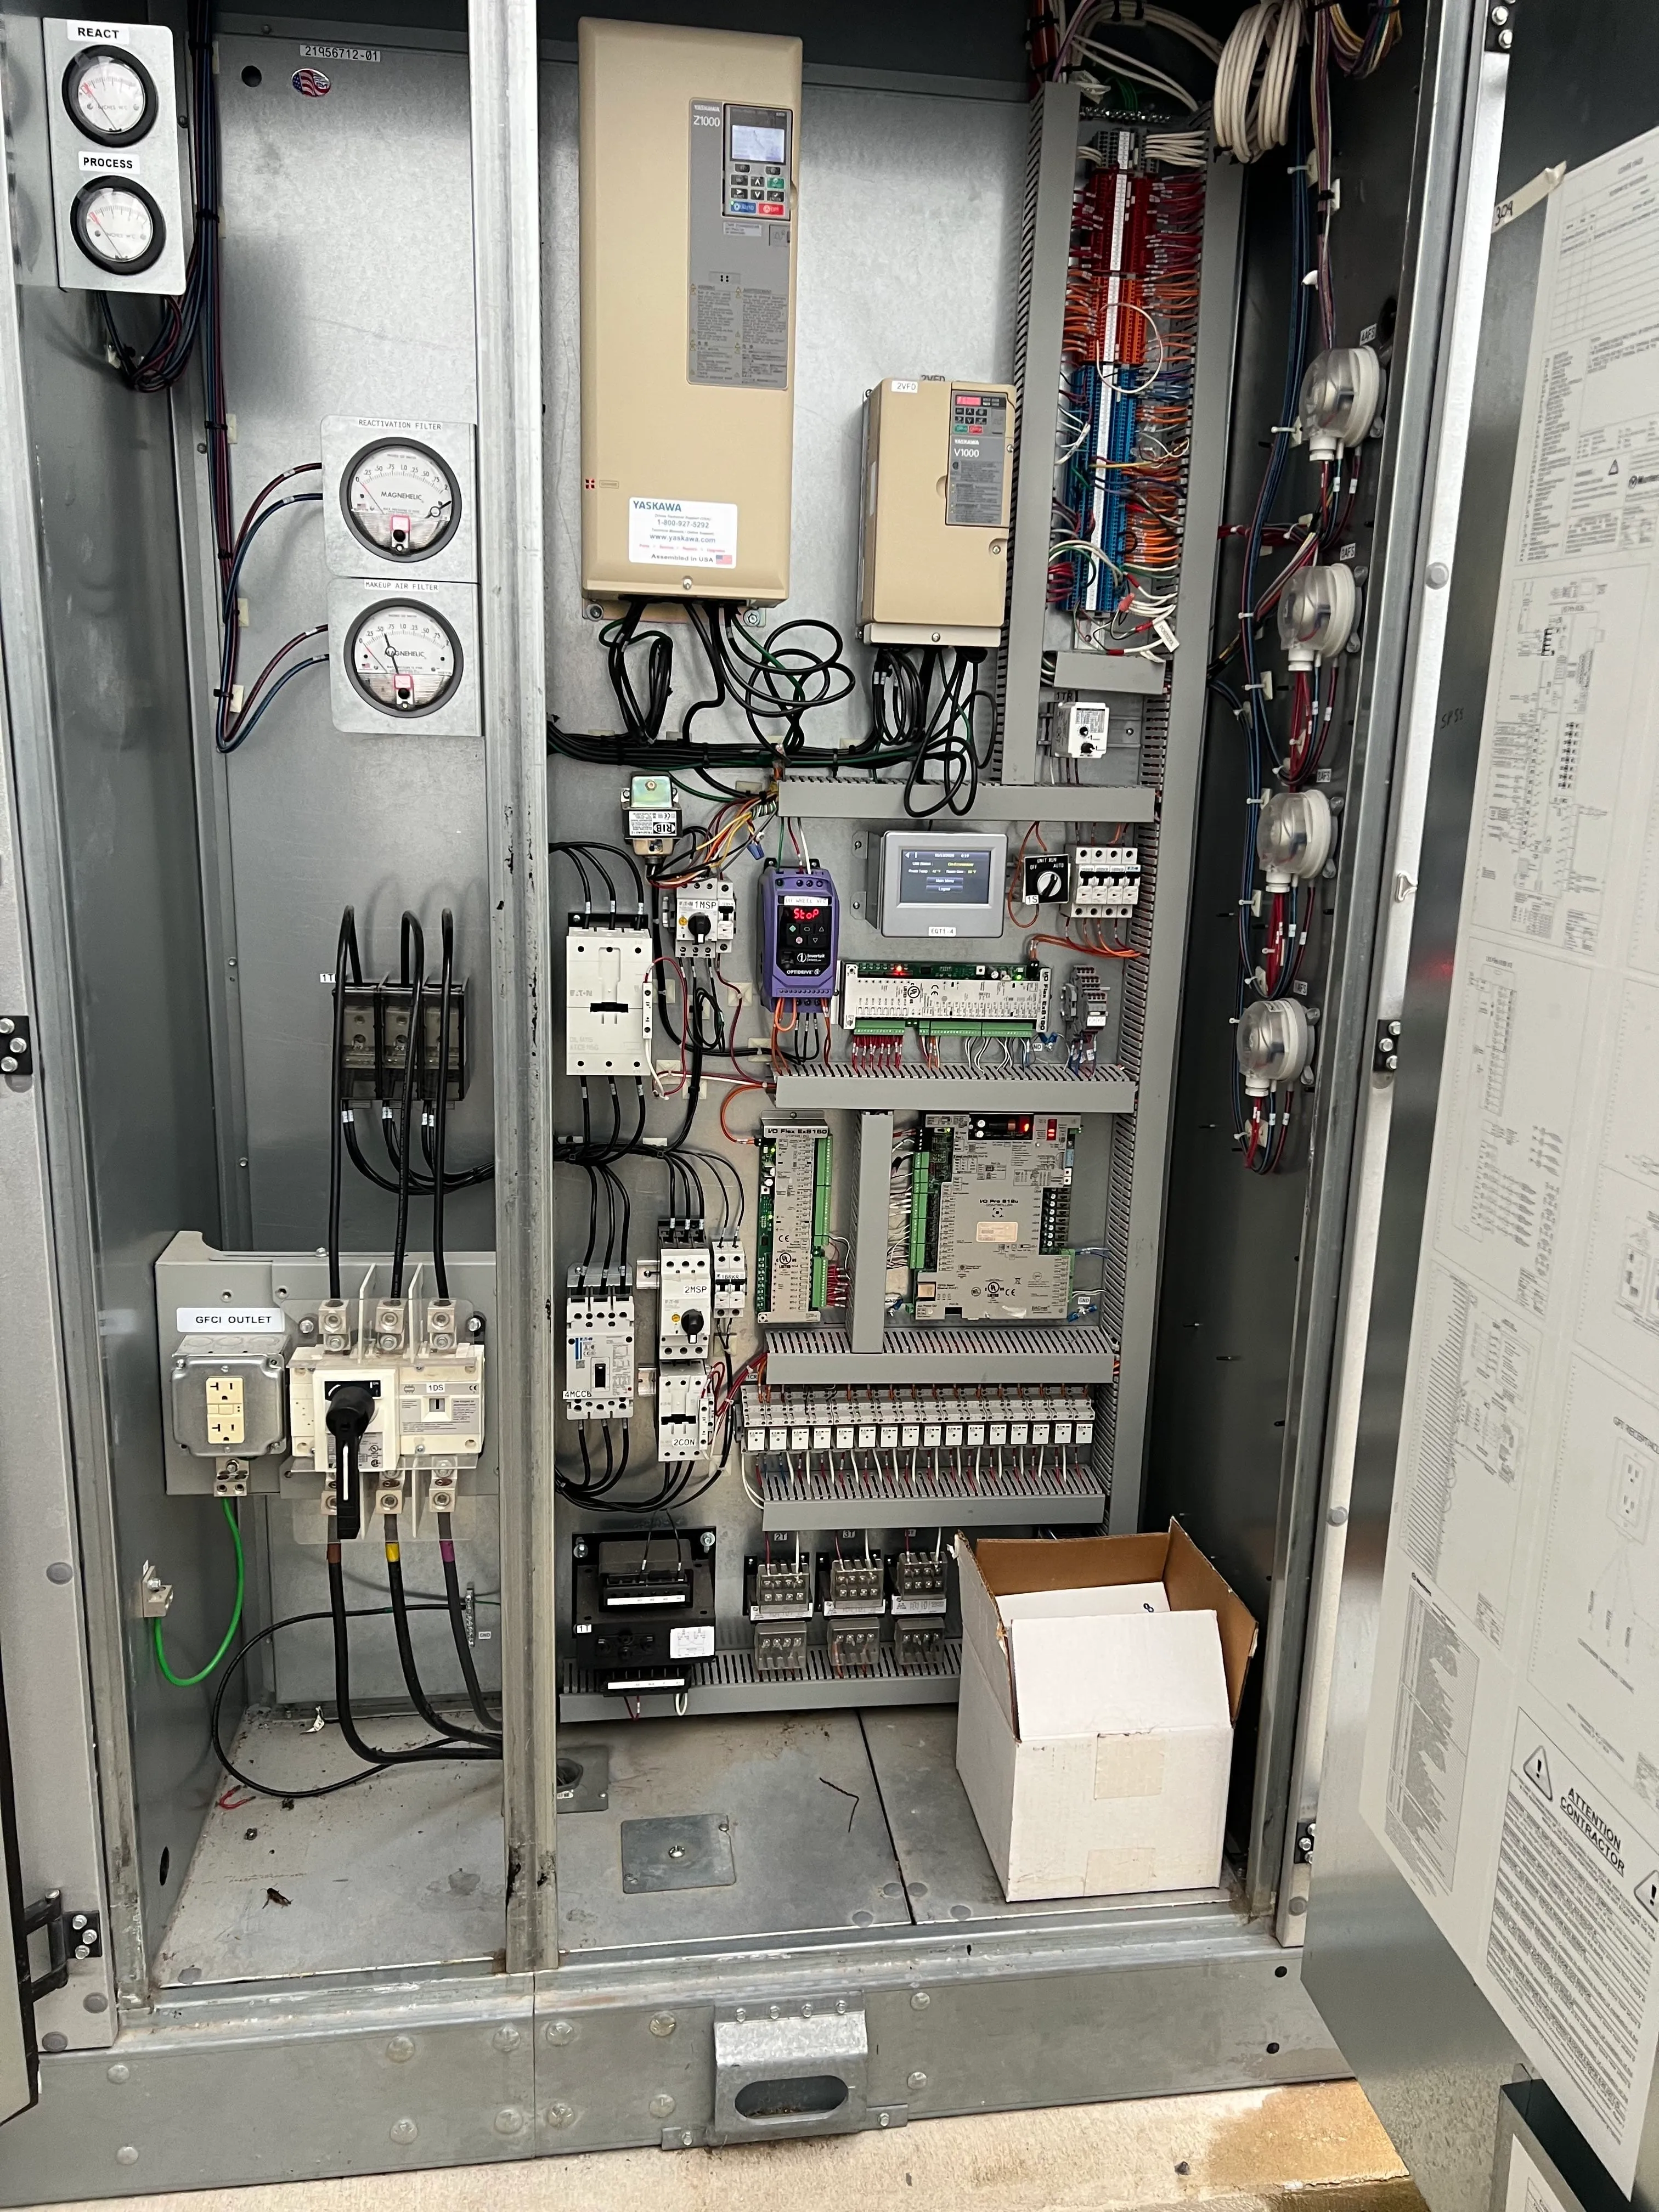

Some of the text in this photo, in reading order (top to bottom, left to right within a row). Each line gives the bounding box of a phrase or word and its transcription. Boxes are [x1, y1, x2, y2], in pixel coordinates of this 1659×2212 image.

[78, 27, 120, 39] REACT
[305, 46, 377, 61] 21956712-01
[693, 115, 720, 127] Z1000
[83, 157, 133, 169] PROCESS
[897, 382, 916, 391] 2VFD
[359, 419, 411, 428] REACTIVATION
[954, 448, 979, 458] V1000
[381, 491, 422, 501] MAGNEHELIC
[633, 500, 681, 512] YASKAWA
[657, 519, 709, 528] 1-800-927-5292
[650, 534, 716, 543] www.yaskawa.com
[656, 824, 672, 832] RIB
[1567, 1787, 1621, 1850] ATTENTION
[1560, 1796, 1626, 1872] CONTRACTOR
